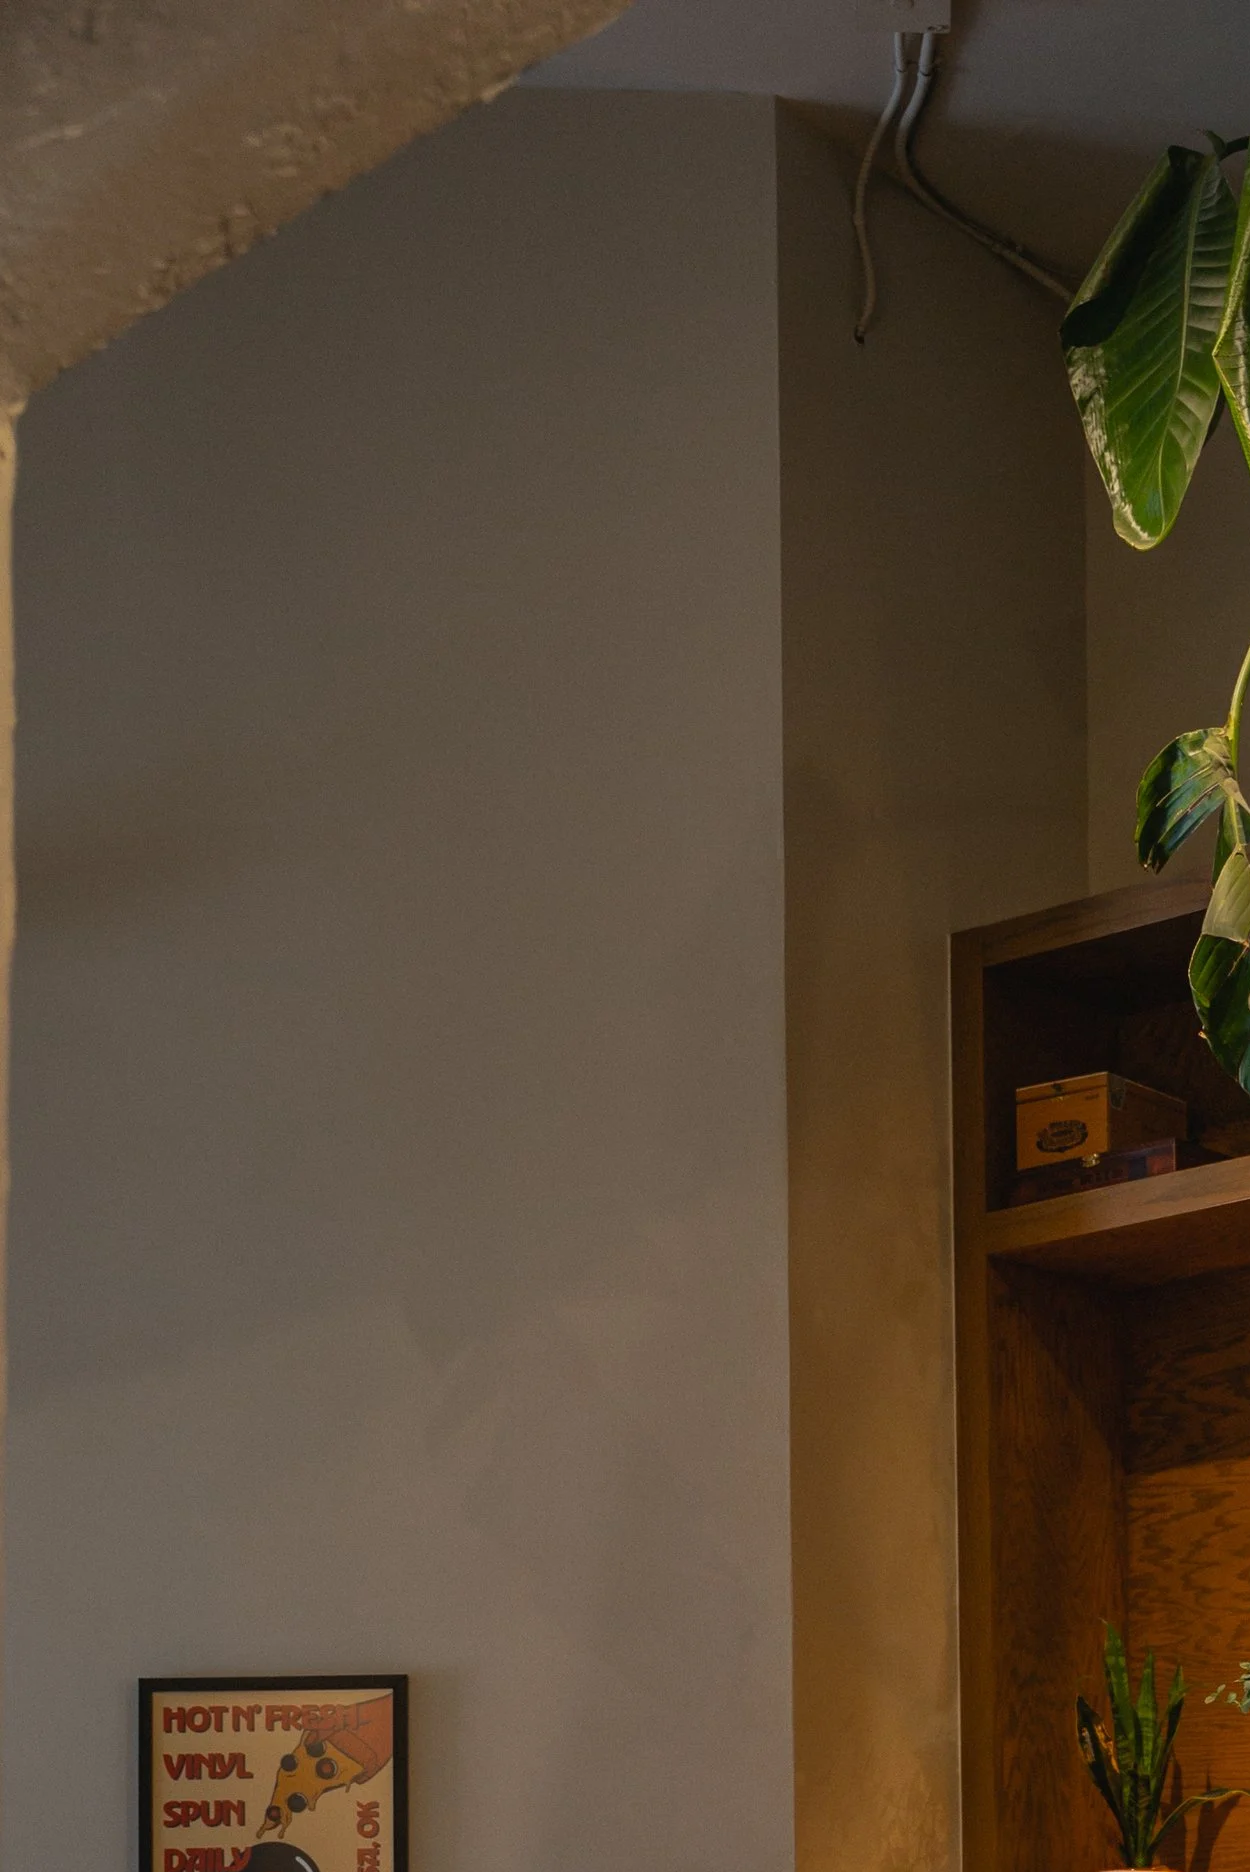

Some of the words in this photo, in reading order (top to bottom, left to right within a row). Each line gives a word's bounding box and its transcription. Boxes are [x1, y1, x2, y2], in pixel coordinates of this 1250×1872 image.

[162, 1705, 228, 1733] HOT
[231, 1703, 262, 1731] N'
[265, 1703, 362, 1732] FRESH
[162, 1752, 253, 1780] VINYL
[162, 1800, 246, 1828] SPUN
[357, 1800, 380, 1839] OK
